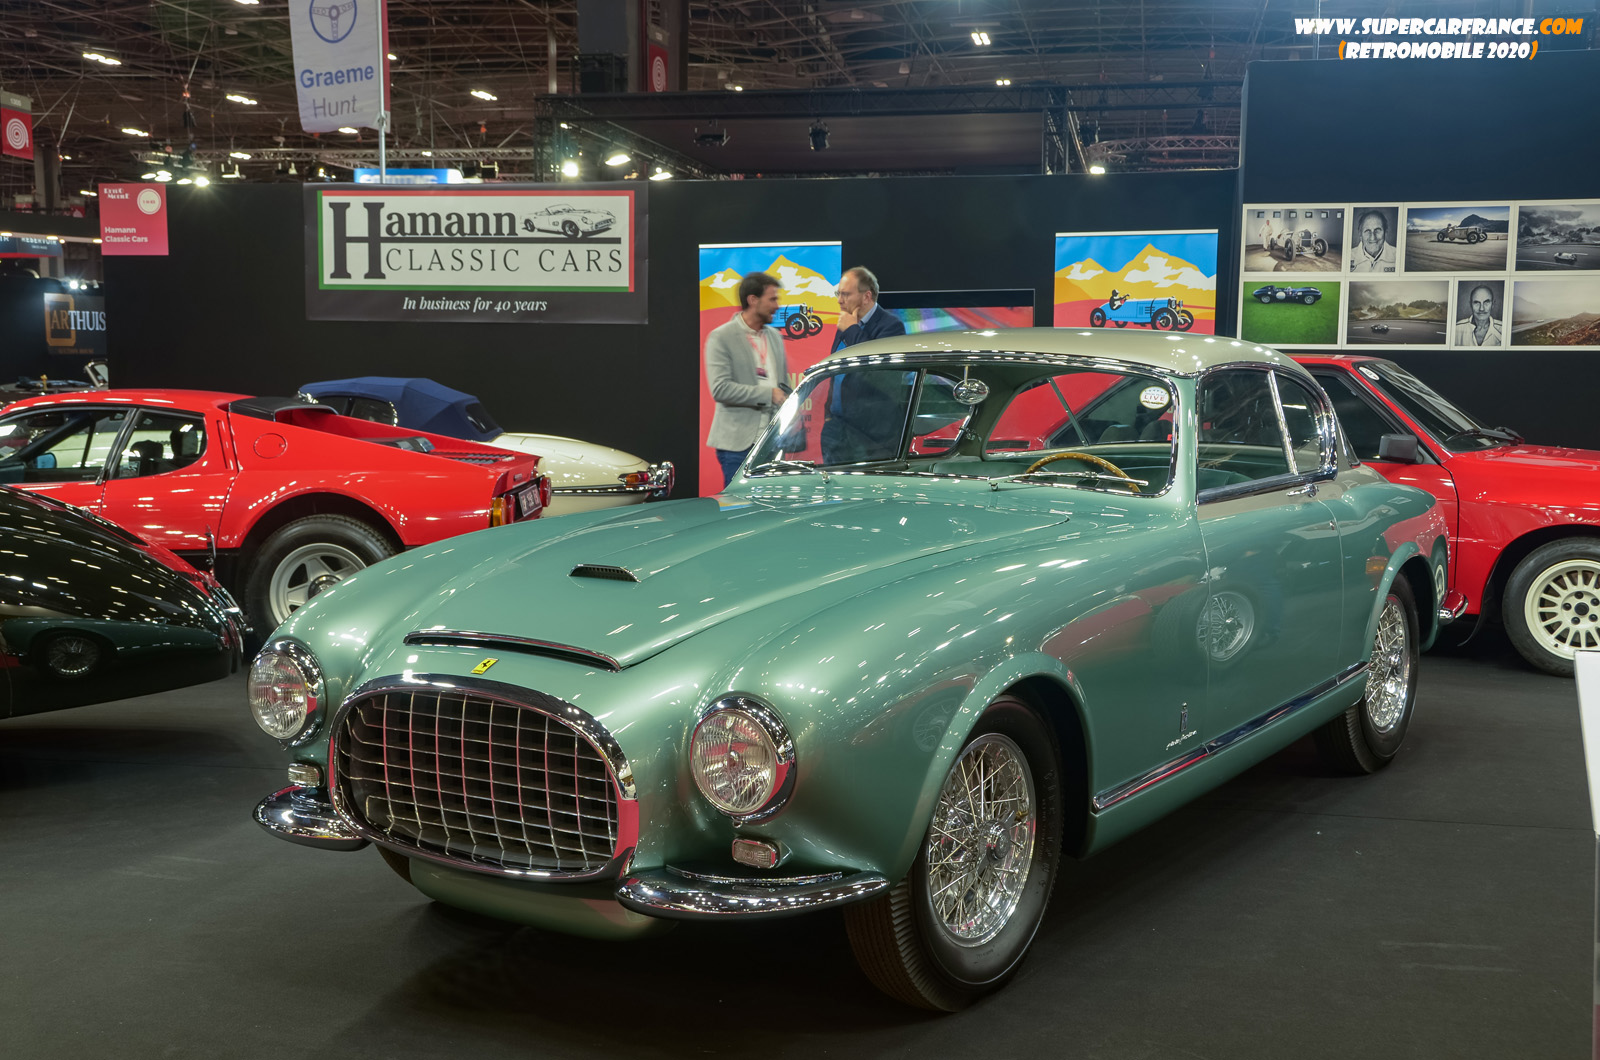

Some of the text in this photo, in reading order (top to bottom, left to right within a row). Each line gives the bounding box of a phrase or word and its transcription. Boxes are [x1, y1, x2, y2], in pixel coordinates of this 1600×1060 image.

[300, 65, 374, 89] Graeme
[312, 94, 358, 119] Hunt
[104, 226, 137, 234] Hamann
[105, 235, 148, 243] Classic Cars
[328, 201, 519, 280] Hamann
[385, 247, 623, 274] CLASSIC CARS
[402, 296, 548, 315] In business for 40 years
[51, 309, 107, 332] ARTHUIS
[1144, 394, 1165, 402] LIVE
